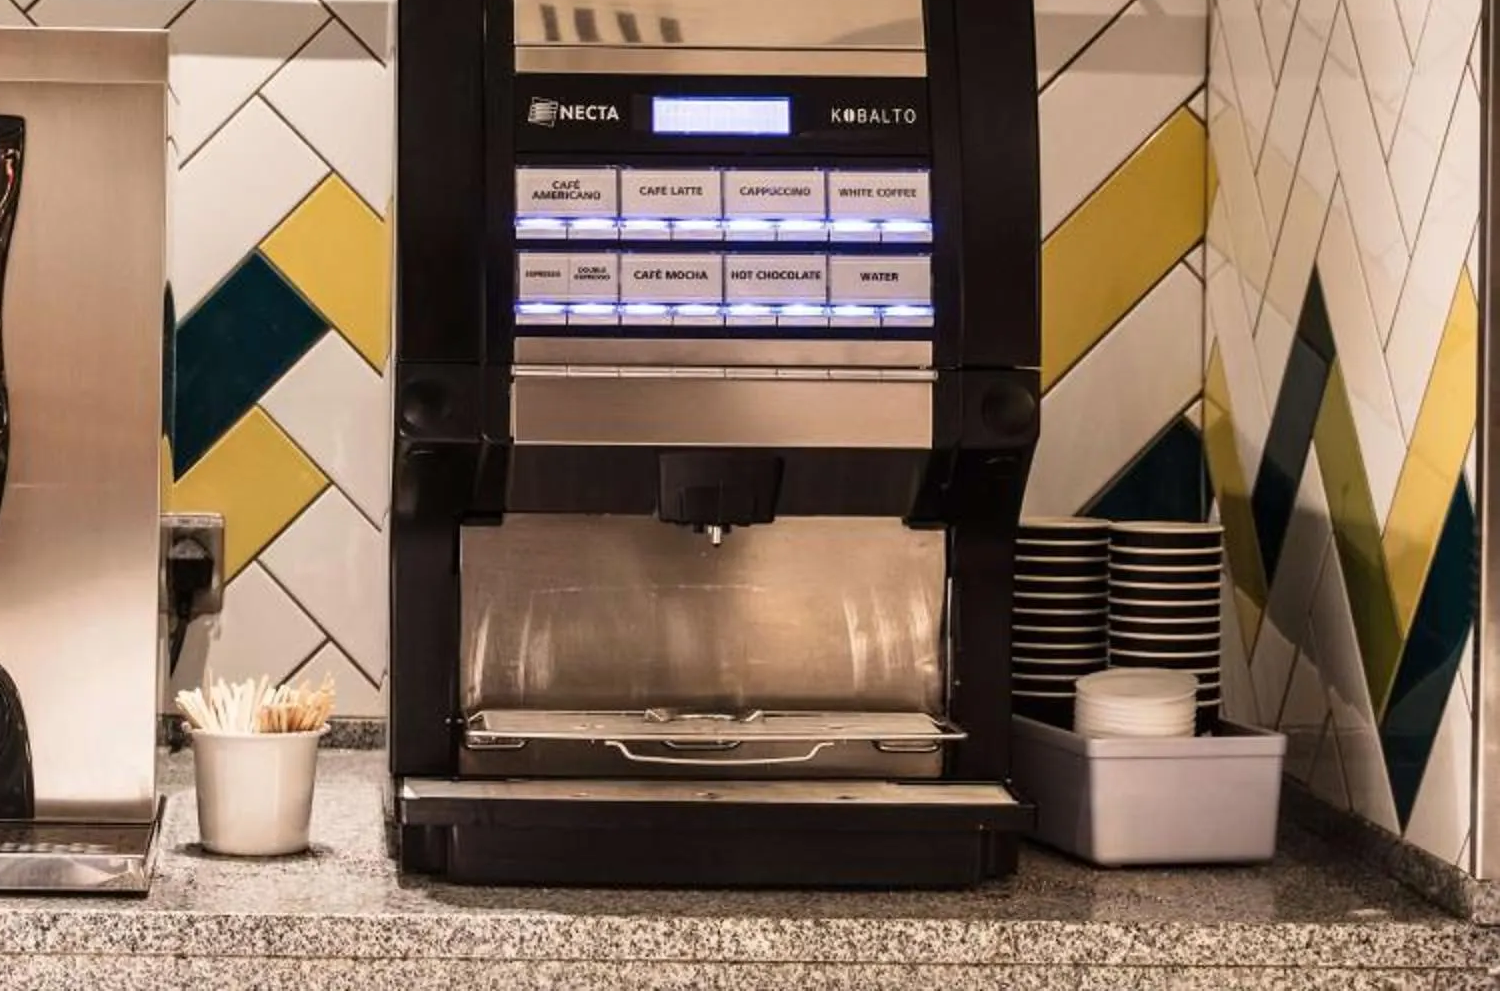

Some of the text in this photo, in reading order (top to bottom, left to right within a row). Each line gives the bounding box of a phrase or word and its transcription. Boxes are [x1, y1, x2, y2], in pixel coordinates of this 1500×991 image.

[558, 104, 620, 122] NECTA
[830, 107, 918, 124] KOBALTO
[552, 179, 581, 190] CAFÉ
[532, 190, 601, 201] AMERICANO
[670, 186, 703, 196] LATTE
[739, 186, 812, 197] CAPPUCCINO
[838, 188, 917, 198] WHITE COFFEE
[665, 271, 709, 281] MOCHA
[730, 270, 821, 281] HOT CHOCOLATE
[859, 272, 899, 282] WATER
